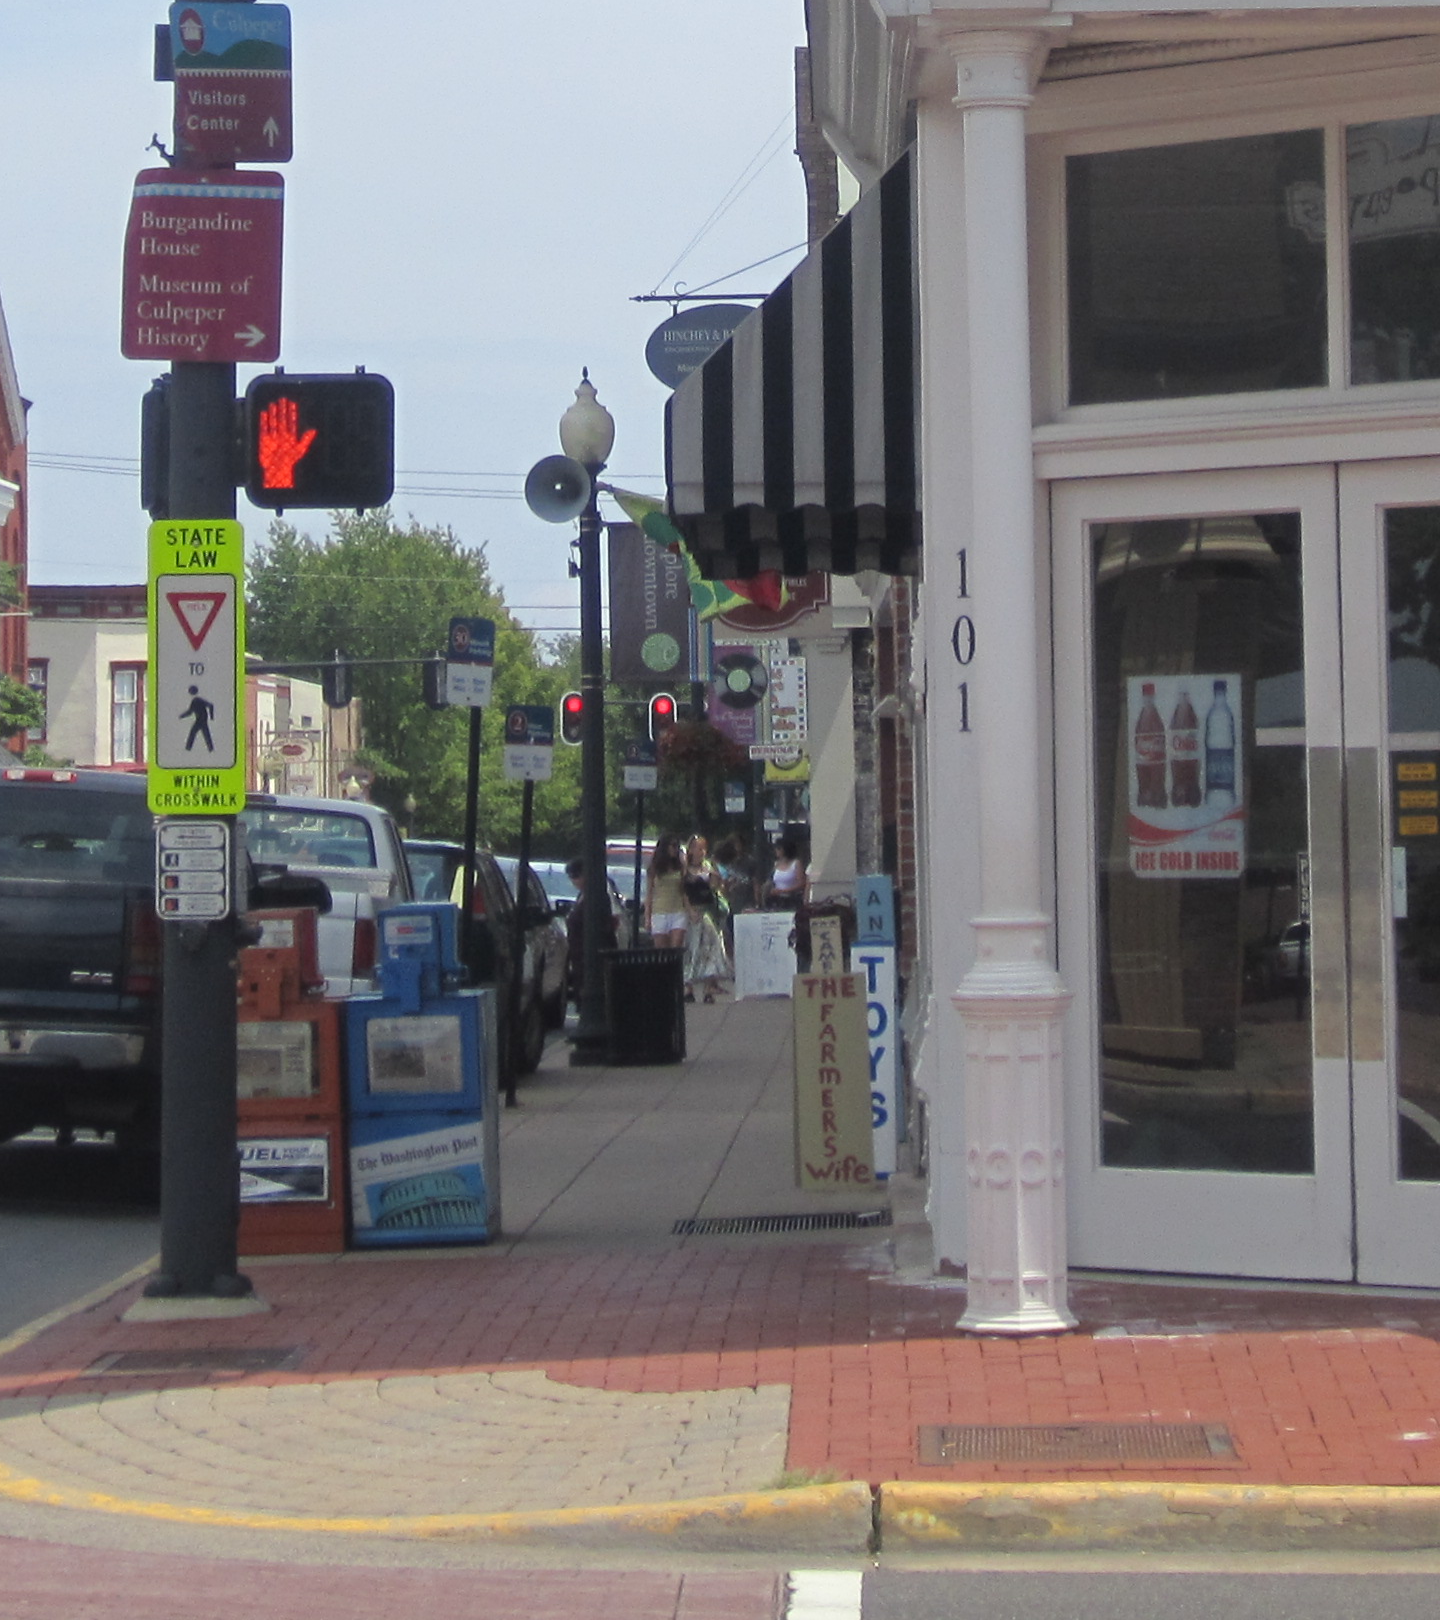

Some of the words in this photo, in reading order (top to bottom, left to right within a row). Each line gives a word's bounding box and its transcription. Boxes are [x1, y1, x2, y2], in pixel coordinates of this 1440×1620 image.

[188, 90, 247, 106] Visitors
[186, 114, 240, 130] Center
[141, 211, 253, 235] Burgandine
[140, 237, 201, 256] House
[139, 274, 222, 294] Museum
[231, 276, 253, 294] of
[137, 300, 226, 325] Culpeper
[137, 327, 210, 347] History
[166, 528, 226, 546] STATE
[176, 551, 217, 568] LAW
[951, 548, 976, 733] 101
[188, 662, 205, 675] TO
[173, 775, 220, 788] WITHIN
[155, 793, 237, 807] CROSSWALK
[1135, 851, 1156, 871] ICE
[1160, 851, 1193, 871] COLD
[1196, 851, 1240, 871] INSIDE
[802, 977, 857, 999] THE
[242, 1147, 284, 1160] UEL
[358, 1157, 377, 1171] The
[380, 1145, 449, 1167] Washington
[452, 1136, 478, 1155] Post
